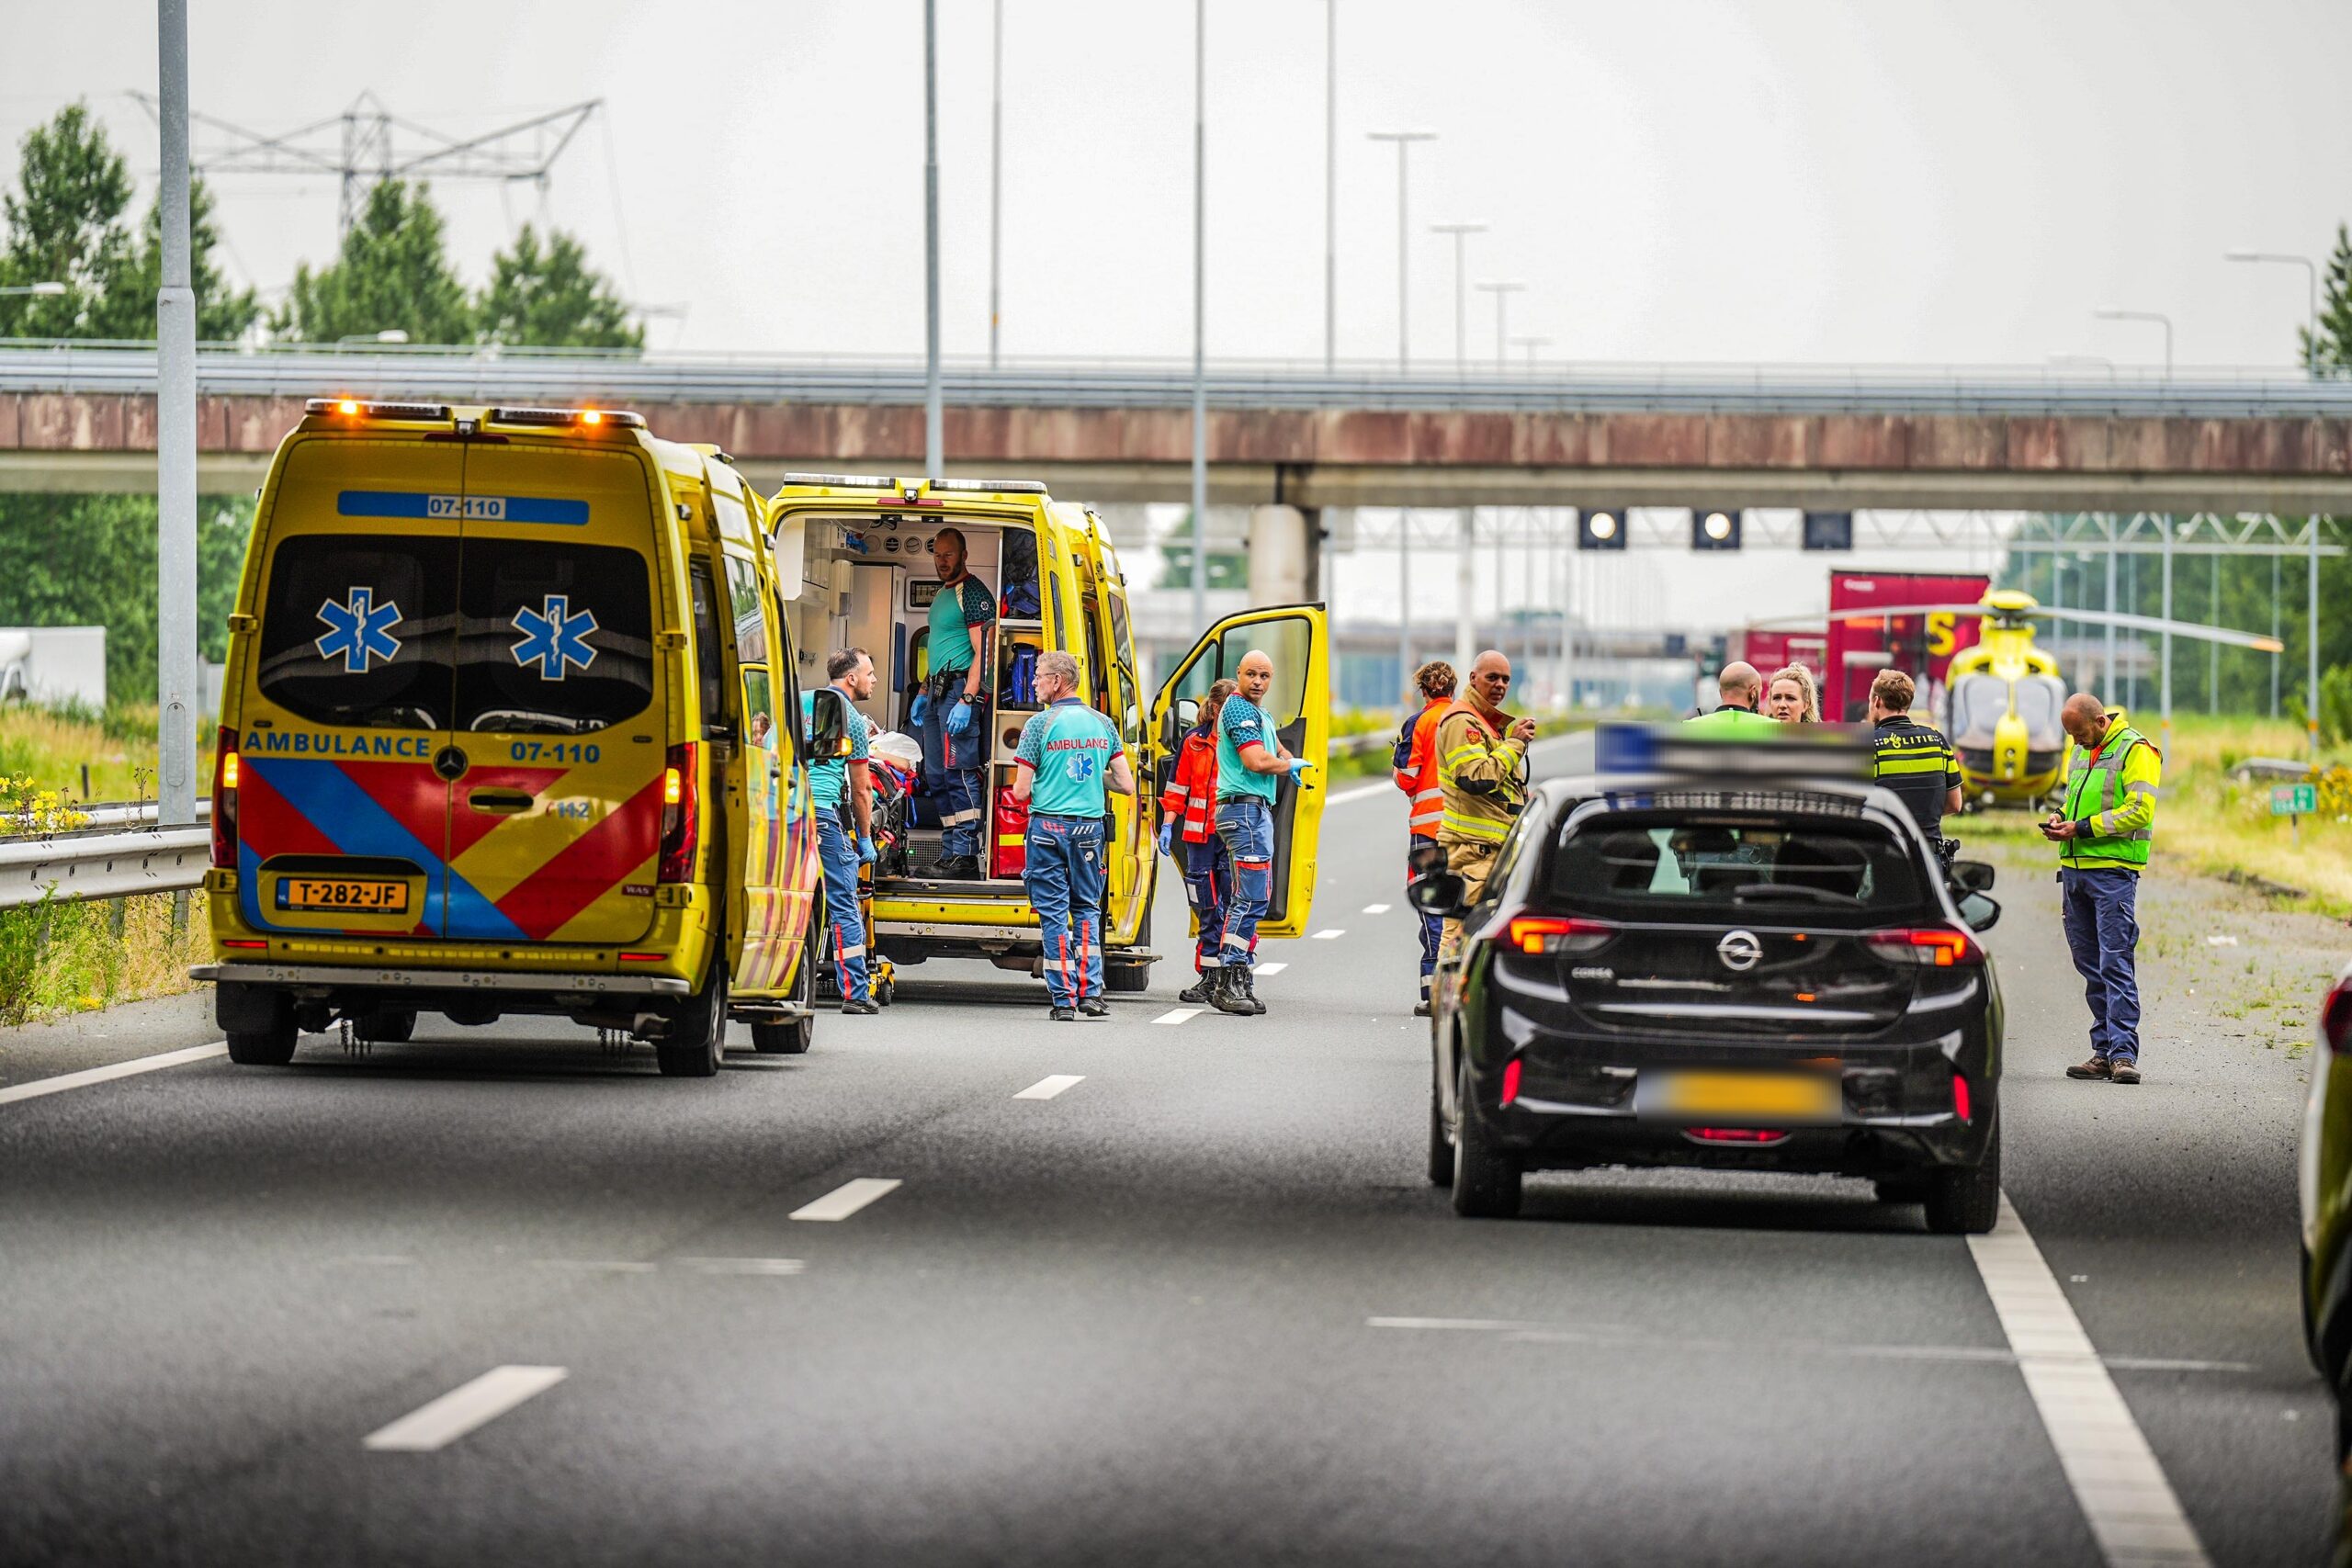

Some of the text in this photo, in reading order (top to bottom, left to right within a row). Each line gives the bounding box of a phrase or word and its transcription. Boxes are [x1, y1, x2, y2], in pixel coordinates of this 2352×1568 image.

[430, 499, 500, 516] 07-110
[243, 731, 431, 757] AMBULANCE
[511, 741, 600, 763] 07-110
[1046, 738, 1108, 751] AMBULANCE
[300, 883, 396, 905] T-282-JF
